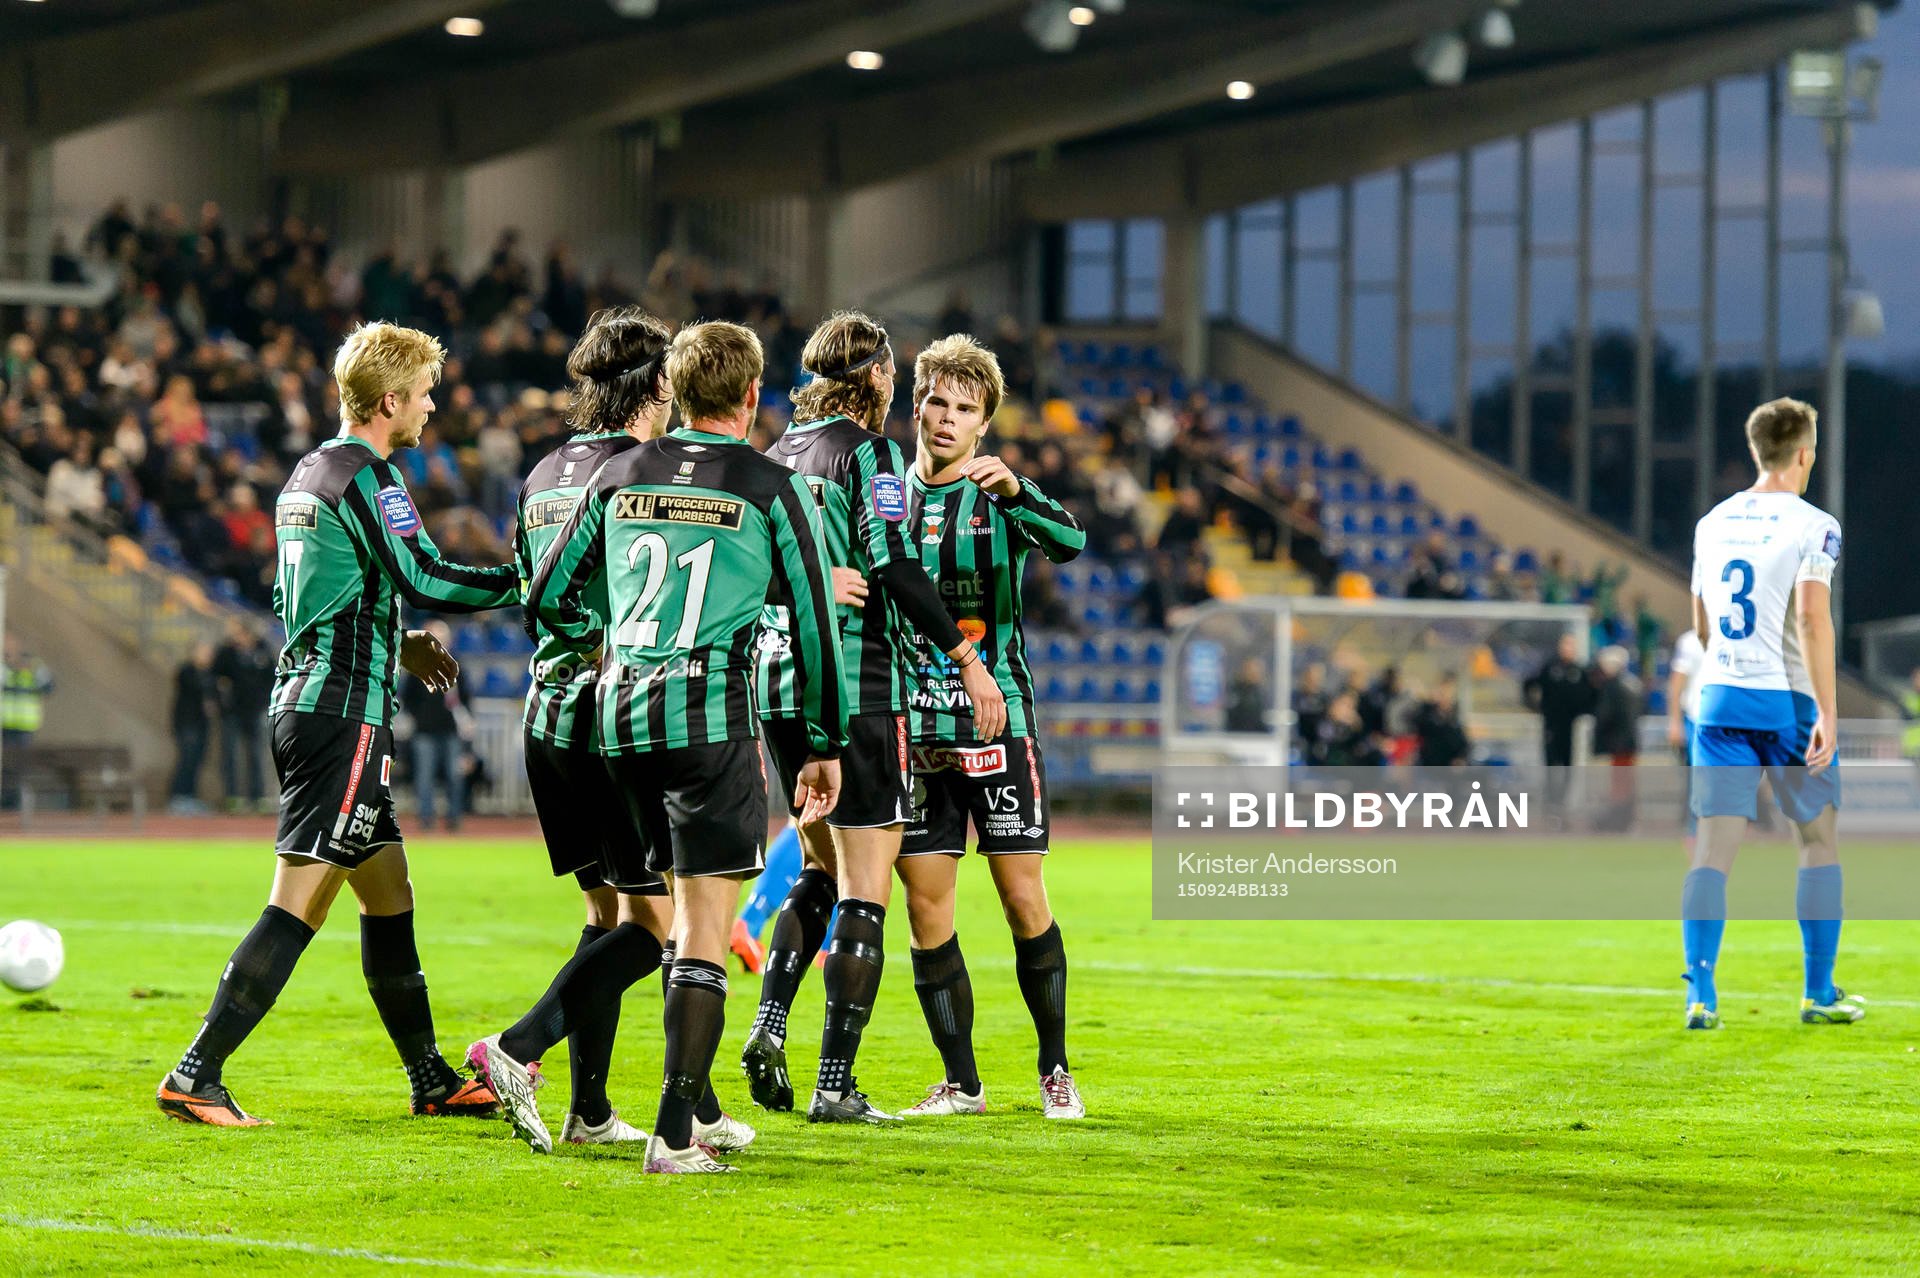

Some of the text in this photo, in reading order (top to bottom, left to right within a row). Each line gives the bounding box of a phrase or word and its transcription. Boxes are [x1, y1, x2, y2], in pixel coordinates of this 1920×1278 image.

[546, 500, 577, 512] BYGGC
[616, 495, 650, 518] XL
[659, 497, 737, 514] BYGGCENTER
[667, 509, 722, 523] VARBERG
[615, 531, 716, 649] 21
[940, 571, 985, 596] ent
[1719, 559, 1757, 640] 3
[345, 733, 368, 806] anderssons markis
[984, 785, 1020, 812] VS
[1007, 828, 1021, 836] SPA
